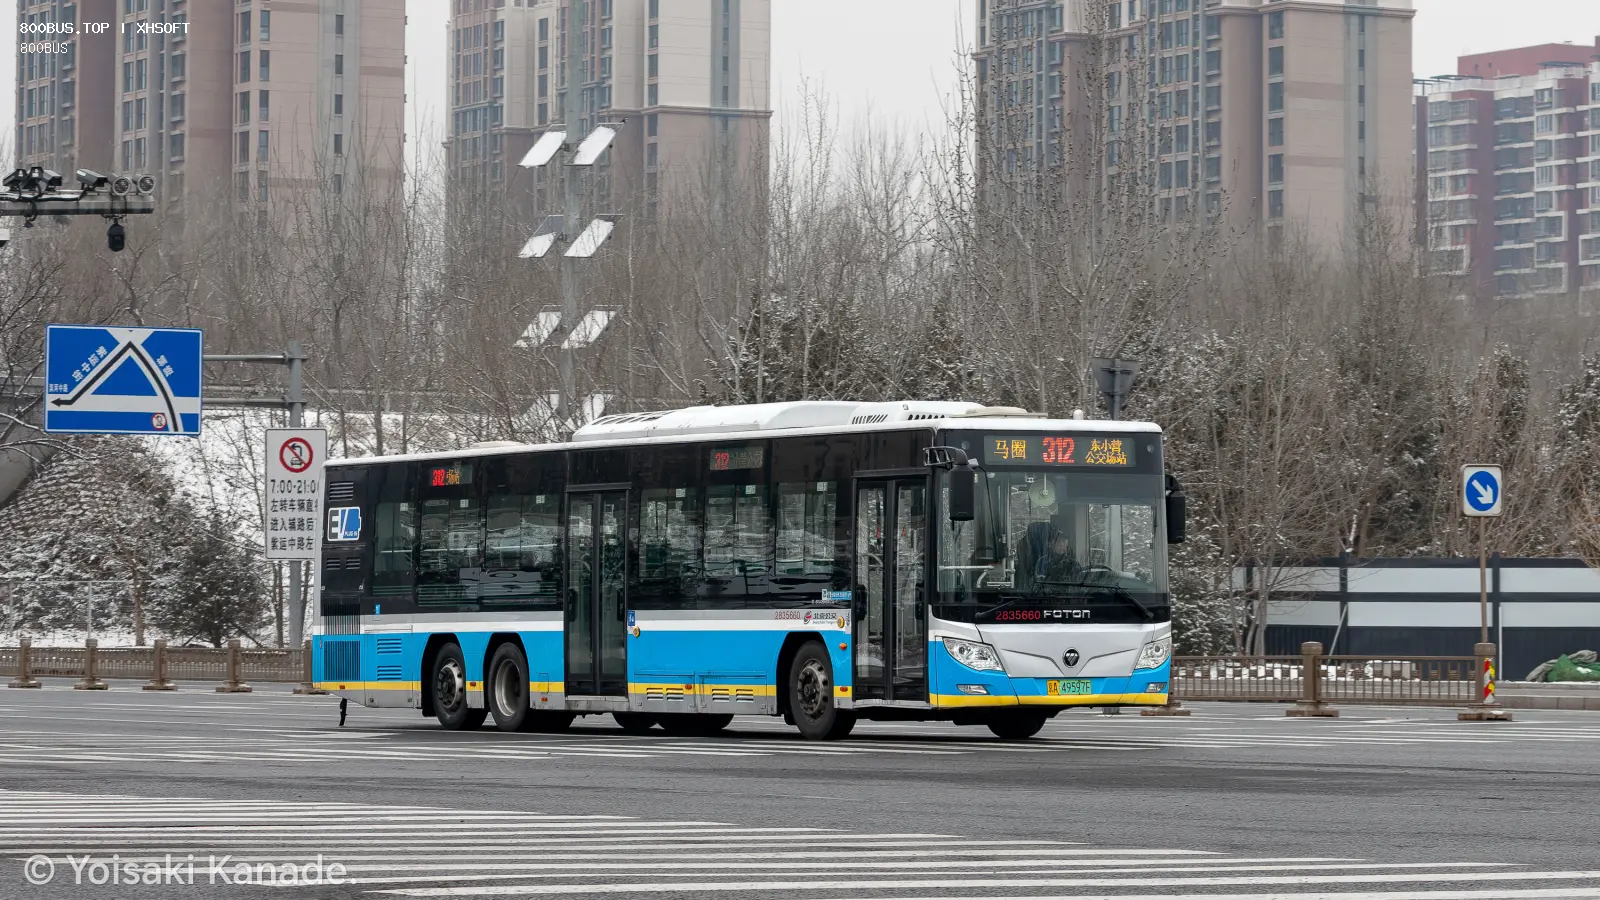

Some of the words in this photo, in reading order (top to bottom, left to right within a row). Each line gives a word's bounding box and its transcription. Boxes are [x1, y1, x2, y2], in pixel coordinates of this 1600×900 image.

[994, 439, 1026, 460] 马圈
[1041, 437, 1075, 464] 312
[1090, 438, 1123, 453] 东小营
[1085, 451, 1127, 465] 公交场站
[270, 517, 317, 532] 进入辅路后
[775, 611, 801, 620] 2835660
[995, 611, 1041, 621] 2835660
[1043, 609, 1091, 619] FOTON
[1061, 681, 1091, 693] 49597F
